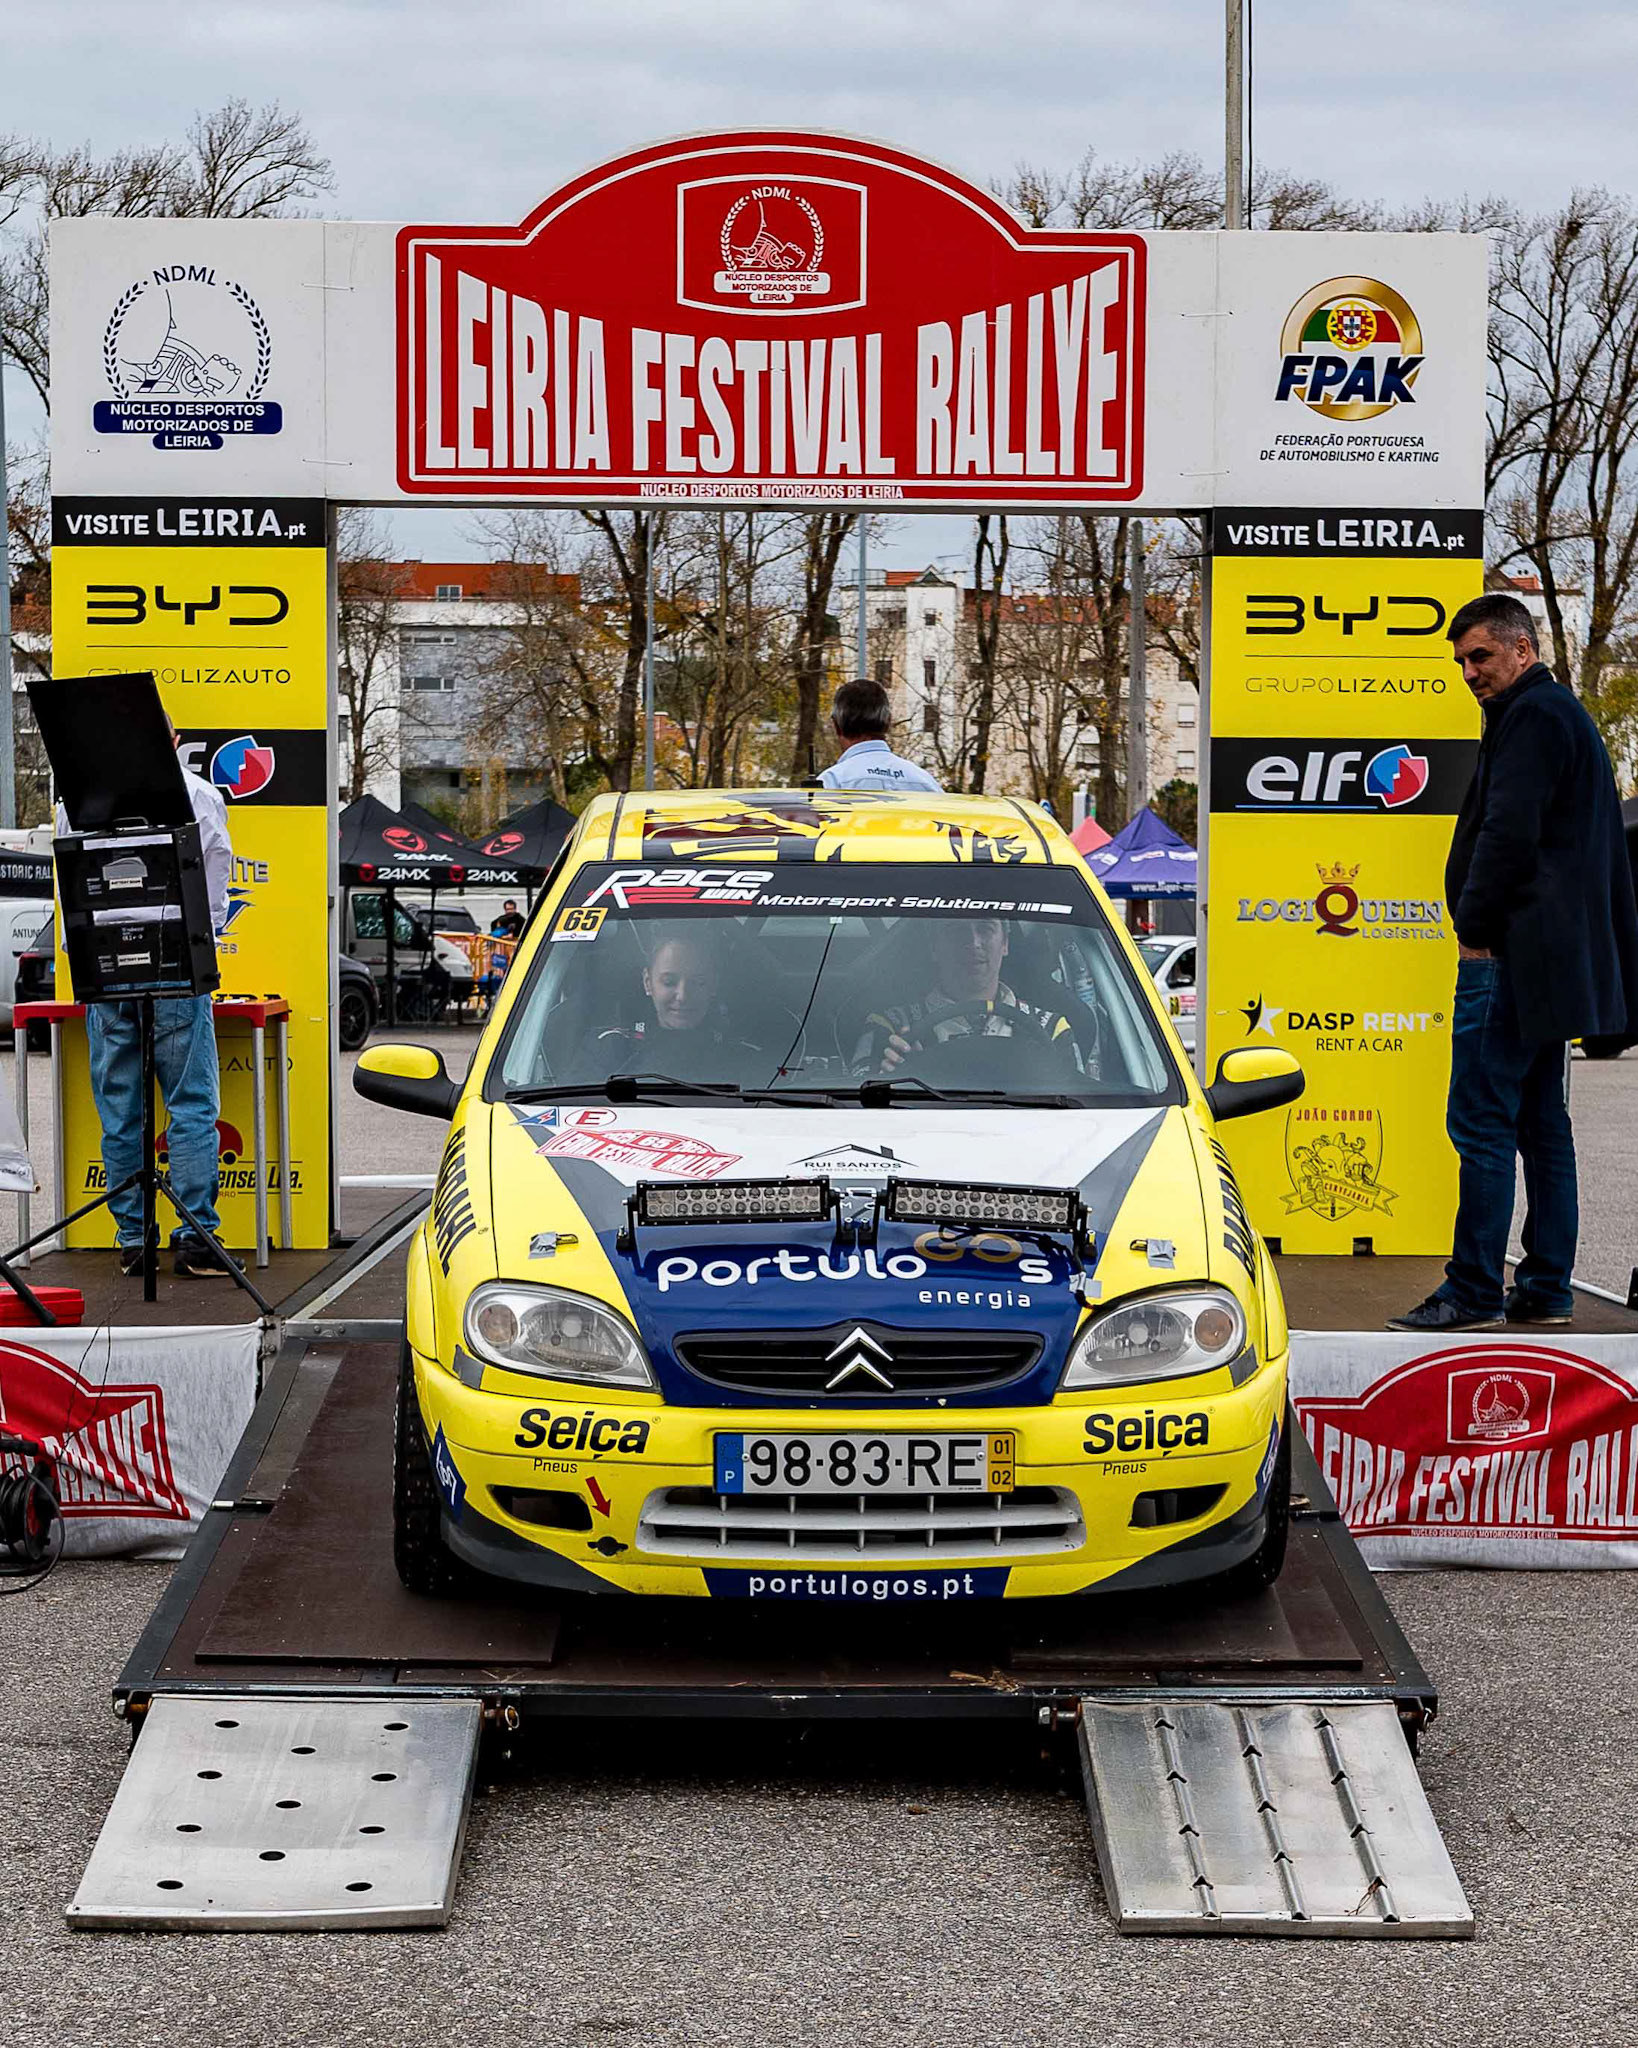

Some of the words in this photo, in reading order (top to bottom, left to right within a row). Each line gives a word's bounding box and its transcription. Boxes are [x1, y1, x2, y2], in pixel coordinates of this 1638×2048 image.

[752, 186, 791, 200] NDML
[153, 265, 218, 287] NDML
[764, 274, 819, 282] DESPORTOS
[732, 283, 797, 291] MOTORIZADOS
[425, 252, 611, 470] LEIRIA
[632, 327, 896, 476] FESTIVAL
[916, 259, 1120, 477] RALLYE
[1275, 355, 1426, 403] FPAK
[110, 401, 171, 416] NÚCLEO
[175, 404, 265, 416] DESPORTOS
[122, 419, 229, 431] MOTORIZADOS
[233, 420, 254, 431] DE
[164, 435, 212, 447] LEIRIA
[1275, 434, 1344, 448] FEDERAÇÃO
[1346, 435, 1424, 447] PORTUGUESA
[1260, 450, 1275, 461] DE
[1277, 450, 1374, 462] AUTOMOBILISMO
[1378, 451, 1386, 461] E
[1388, 451, 1439, 462] KARTING
[690, 484, 759, 497] DESPORTOS
[762, 485, 844, 498] MOTORIZADOS
[848, 485, 863, 498] DE
[866, 486, 903, 499] LEIRIA
[65, 514, 149, 535] VISITE
[156, 508, 306, 539] LEIRIA.pt
[1227, 524, 1310, 546] VISITE
[1317, 519, 1465, 550] LEIRIA.pt
[86, 585, 289, 625] BYD
[1246, 595, 1446, 635] BYD
[1246, 752, 1362, 802] elf
[377, 867, 430, 881] 24MX
[467, 869, 519, 883] 24MX
[757, 894, 896, 909] Motorsport
[900, 896, 1015, 911] Solutions
[563, 910, 602, 931] 65
[1362, 926, 1445, 939] LOGÍSTICA
[1288, 1012, 1355, 1031] DASP
[1316, 1038, 1355, 1051] RENT
[1358, 1038, 1369, 1051] A
[1372, 1038, 1403, 1052] CAR
[576, 1110, 608, 1125] E
[1333, 1109, 1373, 1122] GORDO
[641, 1136, 670, 1149] 65
[918, 1289, 1032, 1310] energia
[1489, 1374, 1513, 1384] NDML
[514, 1408, 650, 1460] Seiça
[1083, 1409, 1209, 1457] Seiça
[994, 1440, 1010, 1455] 01
[533, 1458, 578, 1473] Pneus
[1103, 1462, 1147, 1476] Pneus
[724, 1470, 735, 1483] P
[991, 1470, 1011, 1485] 02
[1408, 1448, 1554, 1524] FESTIVAL
[749, 1573, 975, 1600] portulogos.pt
